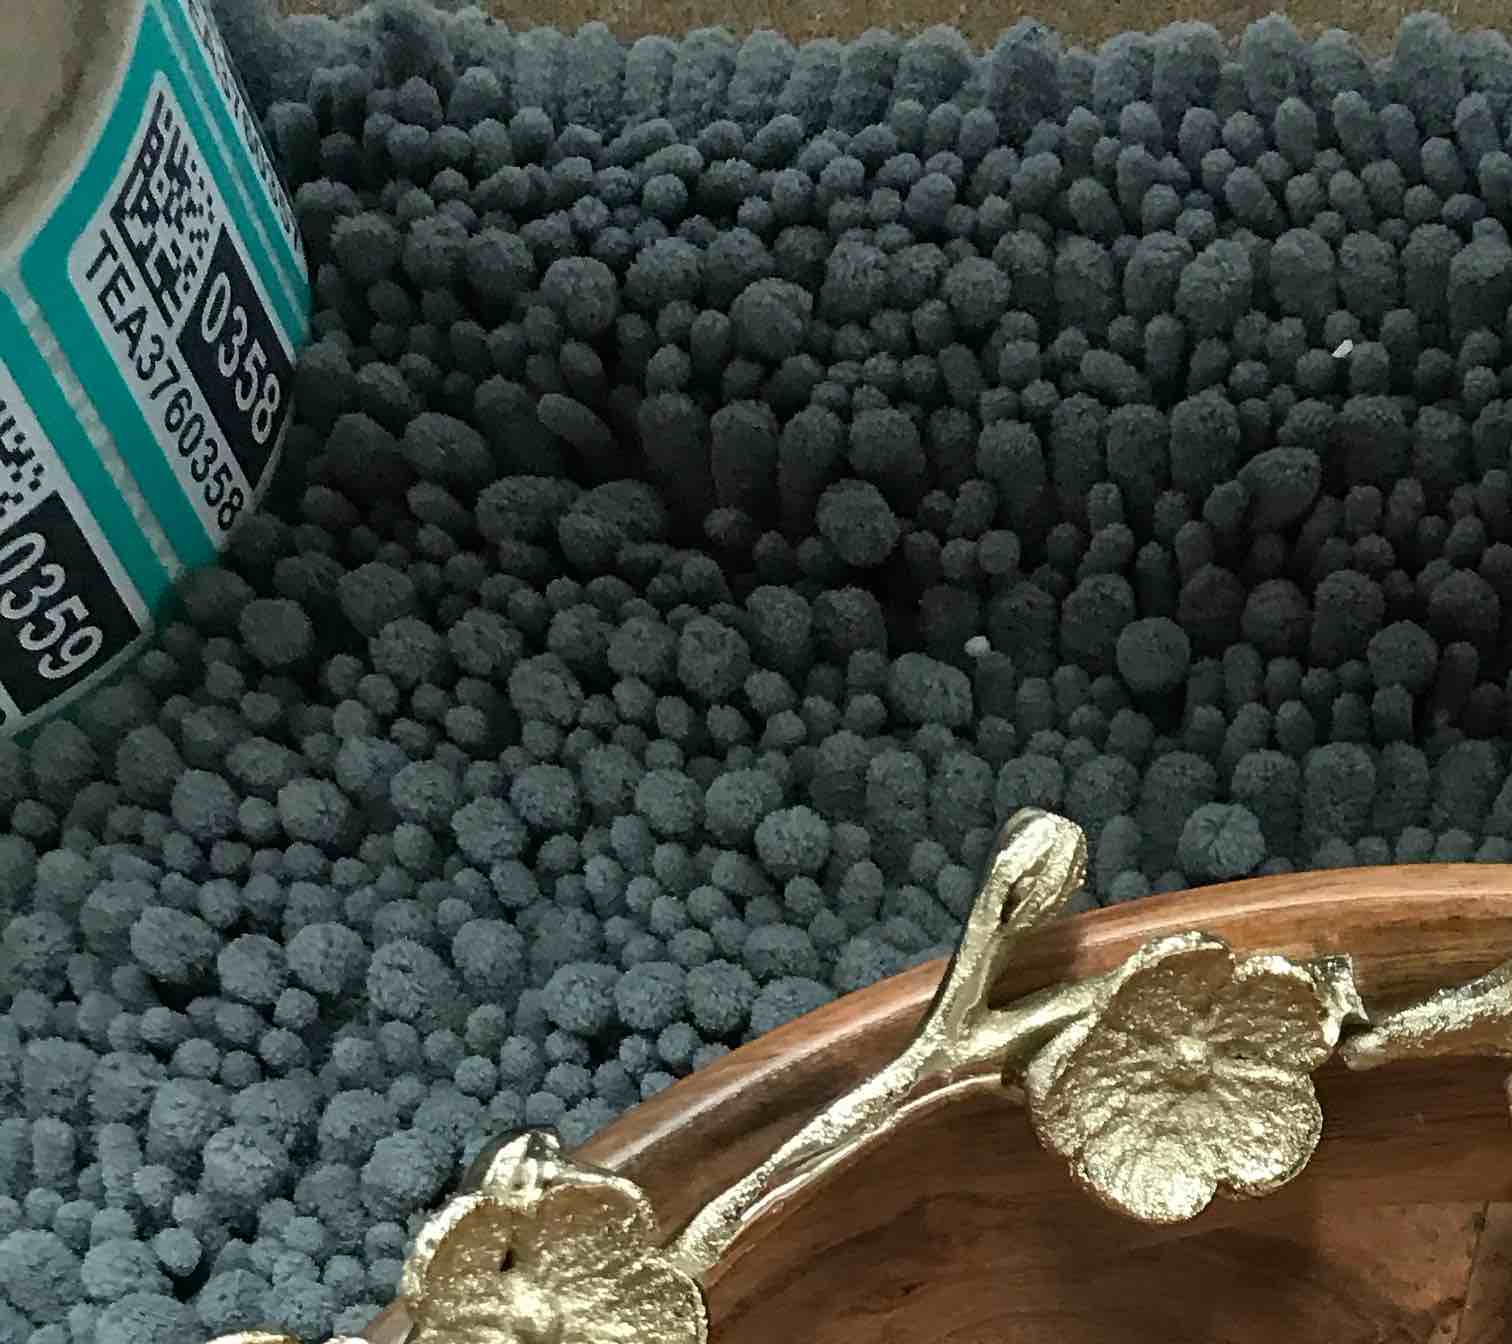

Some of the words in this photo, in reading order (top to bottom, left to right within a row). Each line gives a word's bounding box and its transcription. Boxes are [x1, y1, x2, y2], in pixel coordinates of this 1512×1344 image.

[86, 229, 244, 530] TEA3760358
[201, 271, 280, 444] 0358
[0, 532, 103, 679] 0359
